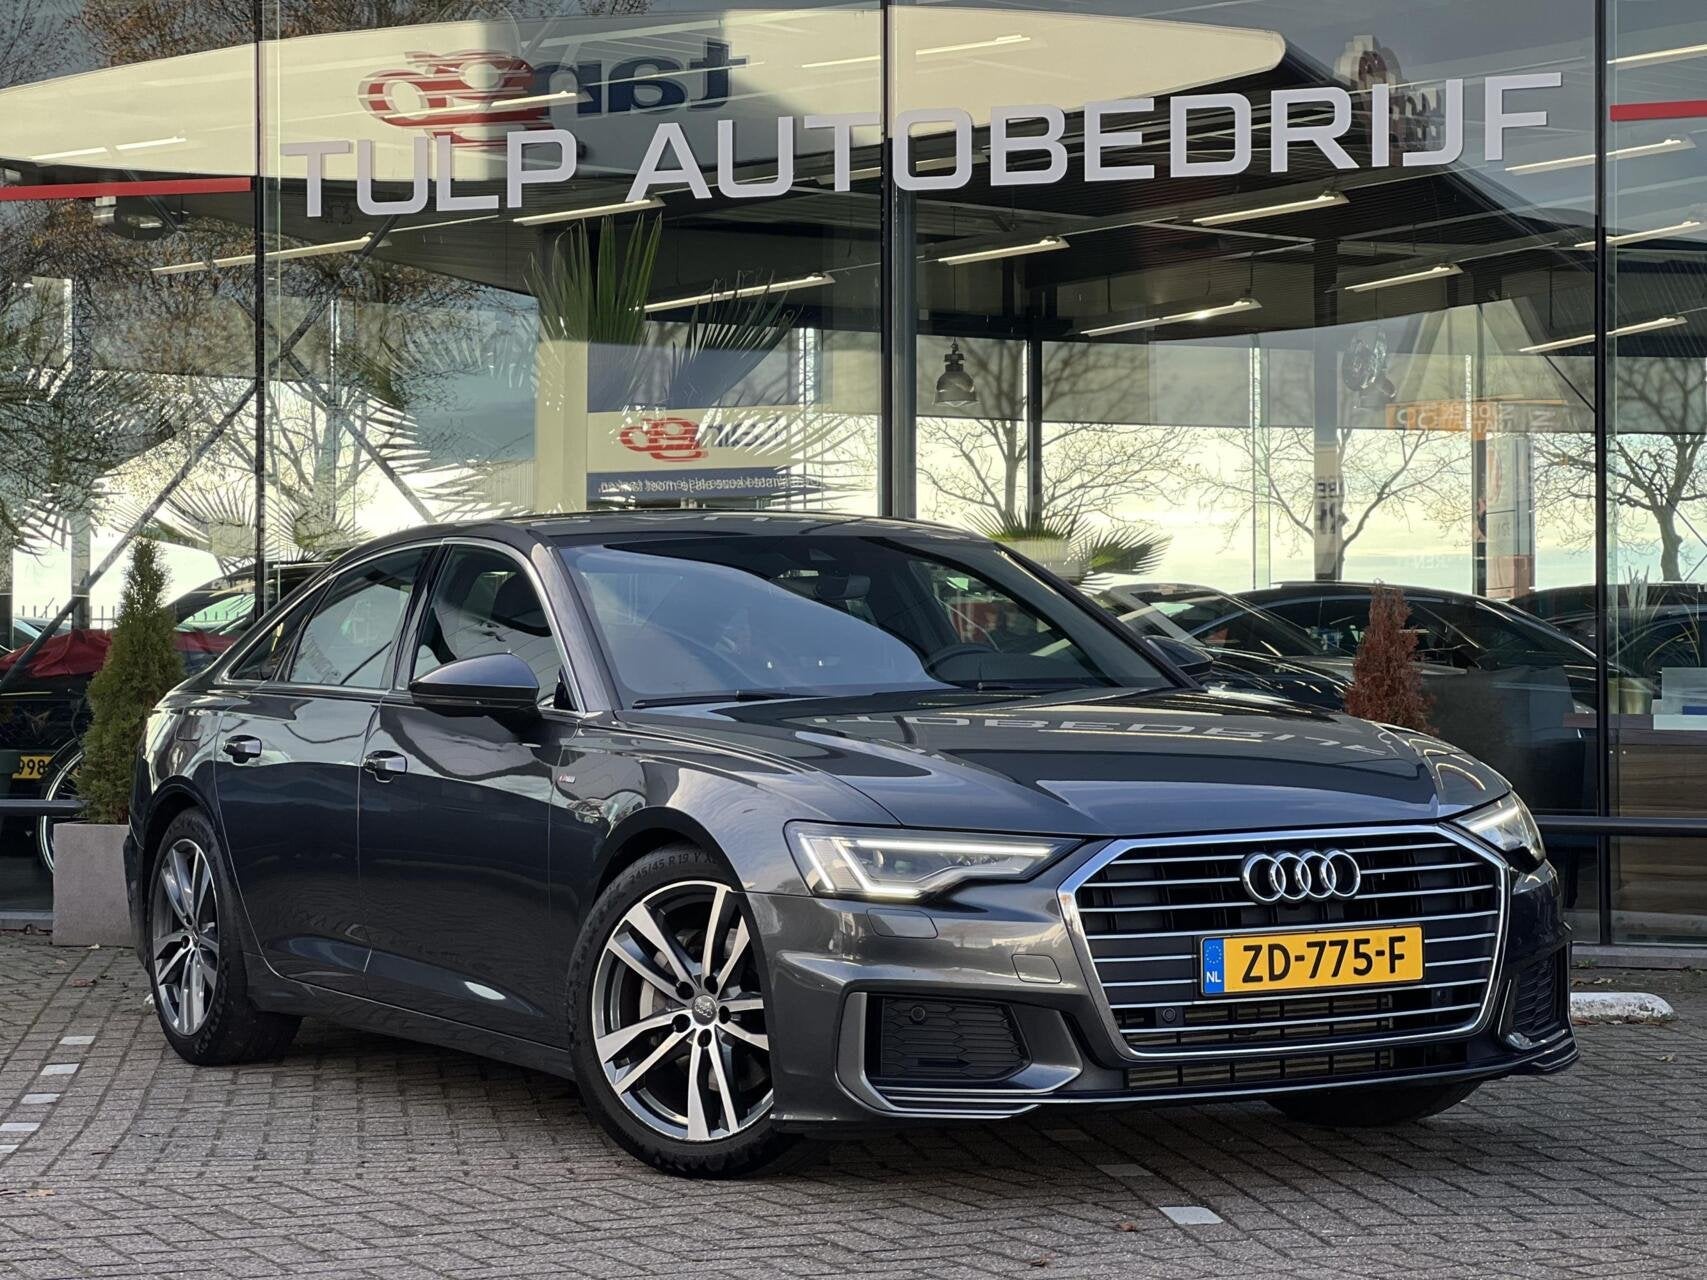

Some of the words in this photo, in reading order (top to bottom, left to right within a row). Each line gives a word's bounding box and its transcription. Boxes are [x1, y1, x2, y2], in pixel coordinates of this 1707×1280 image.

[281, 129, 577, 218] TULP
[625, 72, 1562, 201] AUTOBEDRIJF
[1206, 971, 1222, 983] NL
[1242, 935, 1406, 983] ZD-775-F
